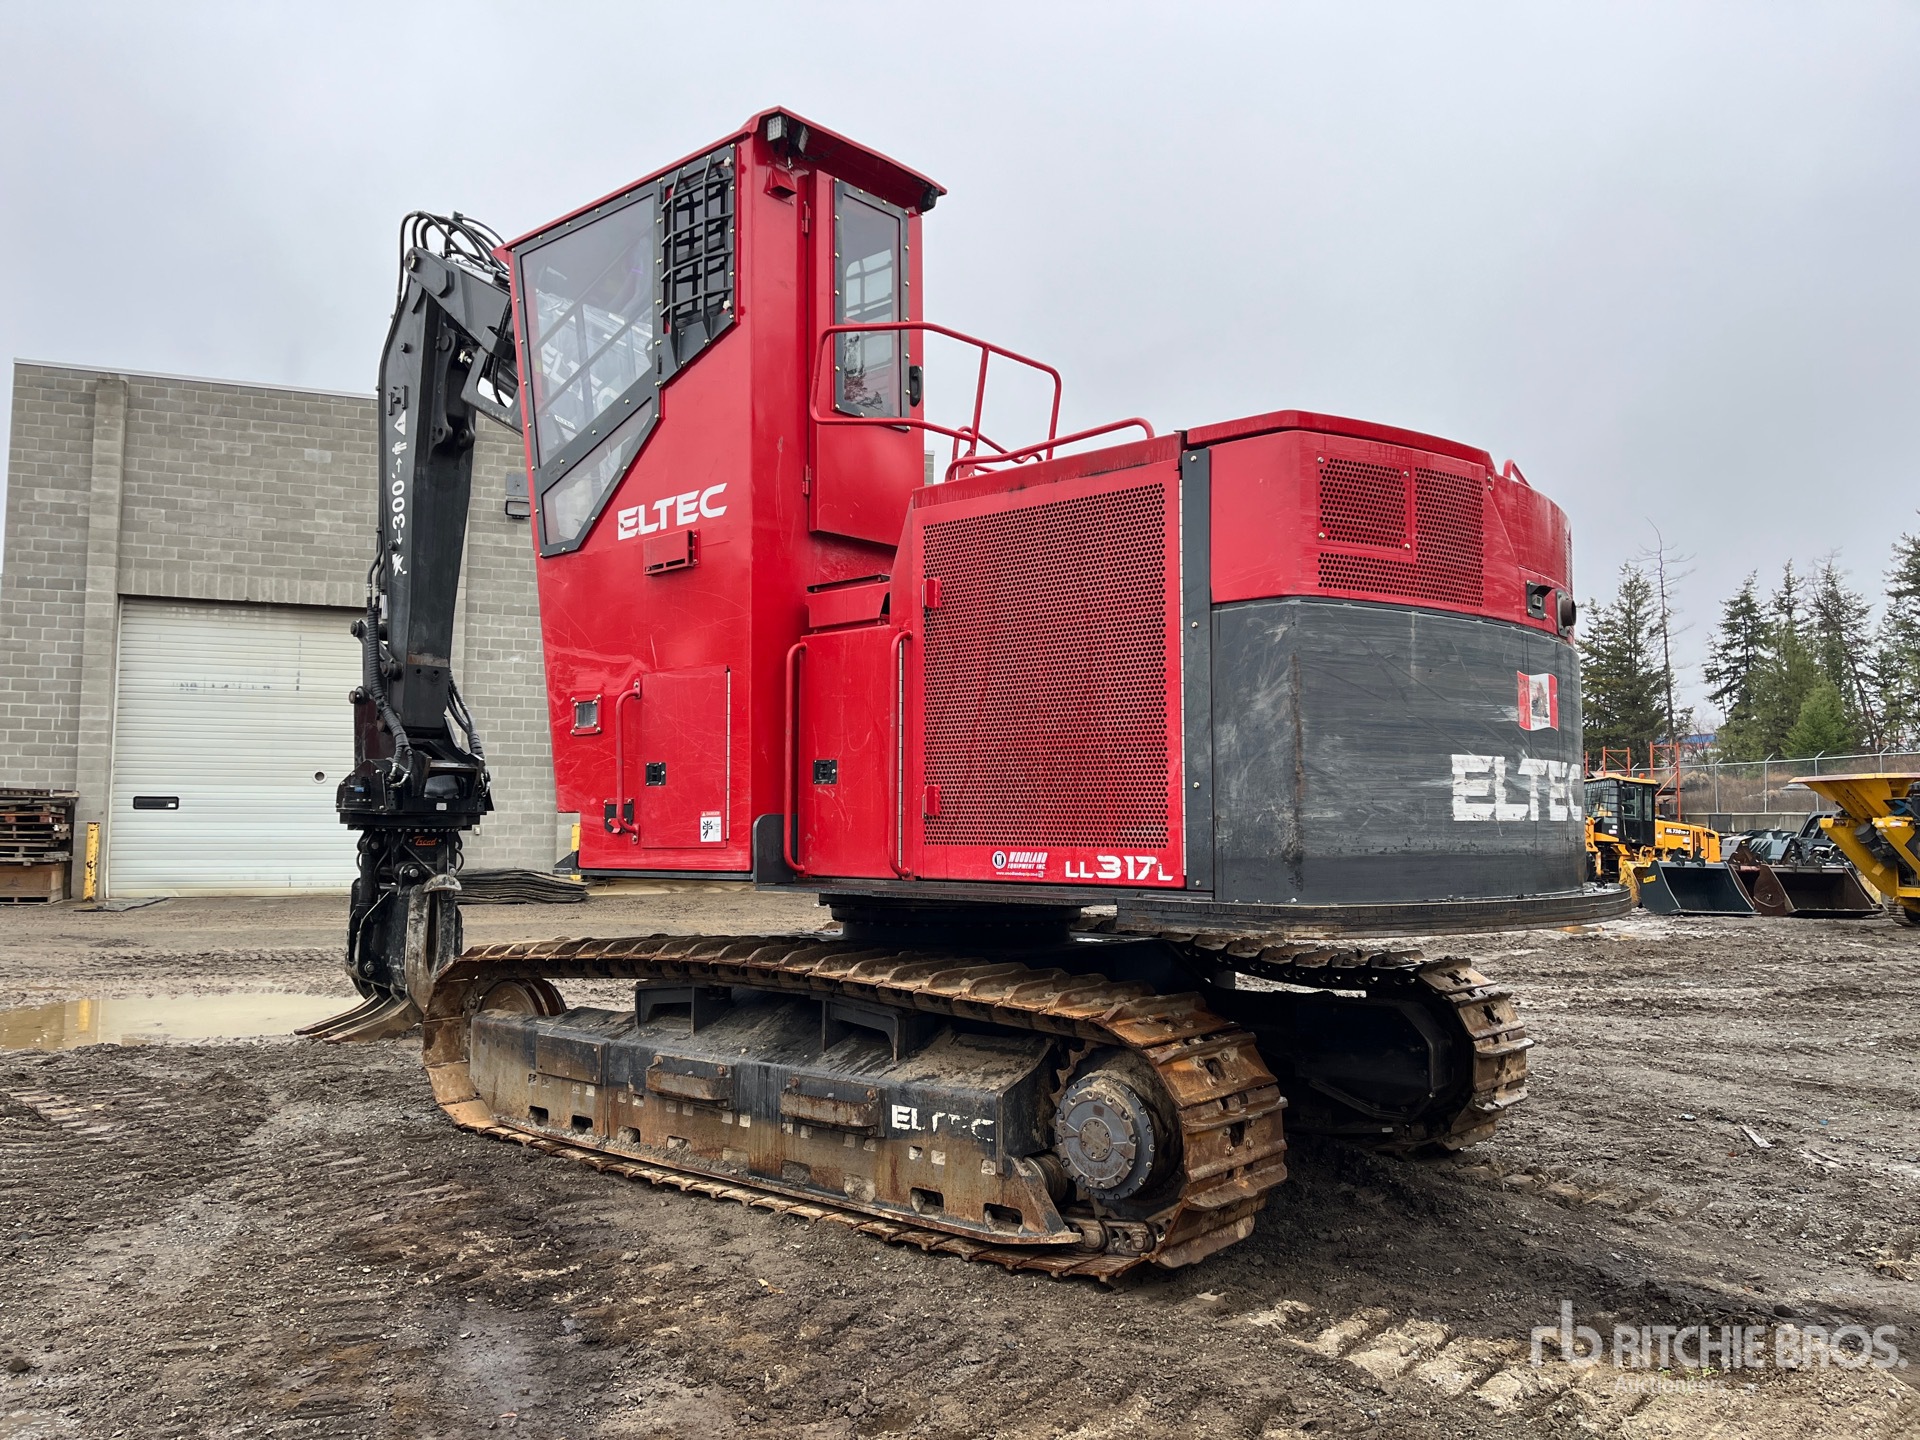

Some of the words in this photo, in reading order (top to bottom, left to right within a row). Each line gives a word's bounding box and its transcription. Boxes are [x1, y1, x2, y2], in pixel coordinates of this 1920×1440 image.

[617, 482, 728, 540] ELTEC
[1451, 754, 1582, 822] ELTEC
[1009, 852, 1048, 864] WOODLAND
